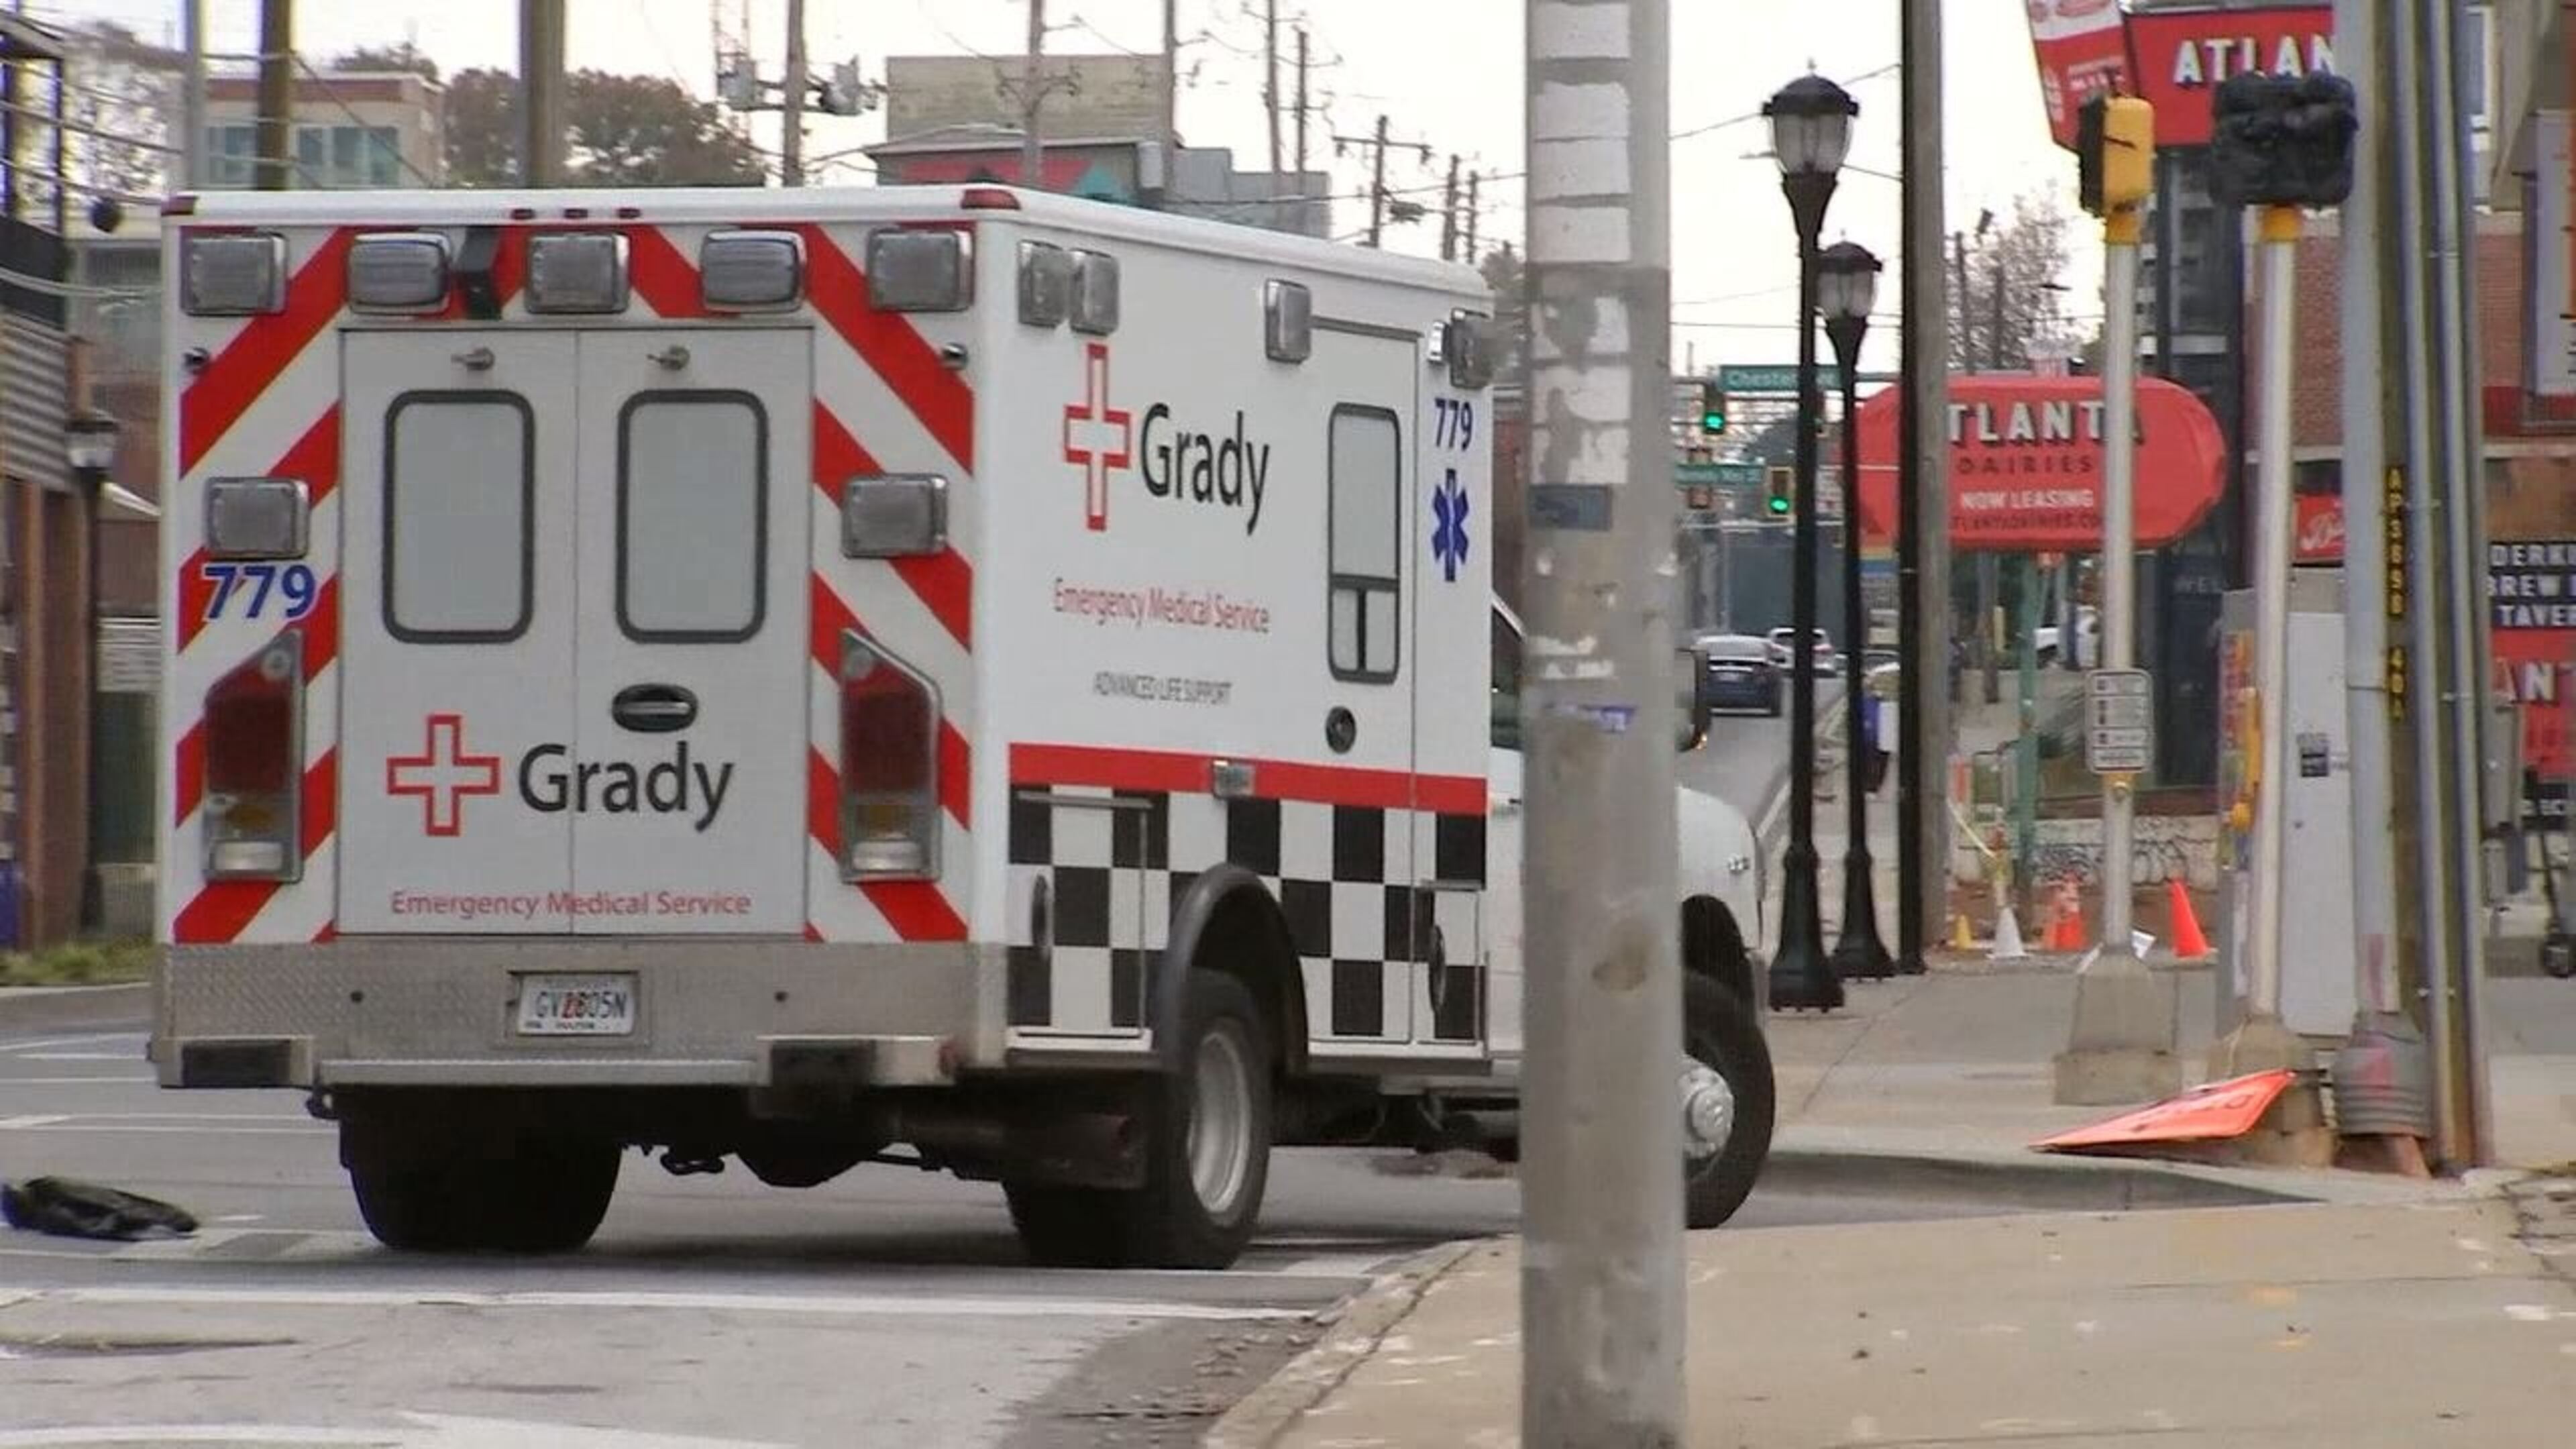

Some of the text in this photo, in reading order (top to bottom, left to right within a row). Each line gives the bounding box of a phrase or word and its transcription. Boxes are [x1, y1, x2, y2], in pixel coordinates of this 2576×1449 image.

[1435, 398, 1472, 451] 779
[1947, 400, 2136, 441] TLANT
[1141, 402, 1269, 536] Grady
[1955, 454, 2093, 474] DAIRIES
[1960, 489, 2094, 510] NOW LEASING
[205, 565, 315, 619] 779
[1055, 577, 1269, 633] Emergency Medical Service
[519, 741, 735, 833] Grady
[390, 891, 751, 919] Emergency Medical Service
